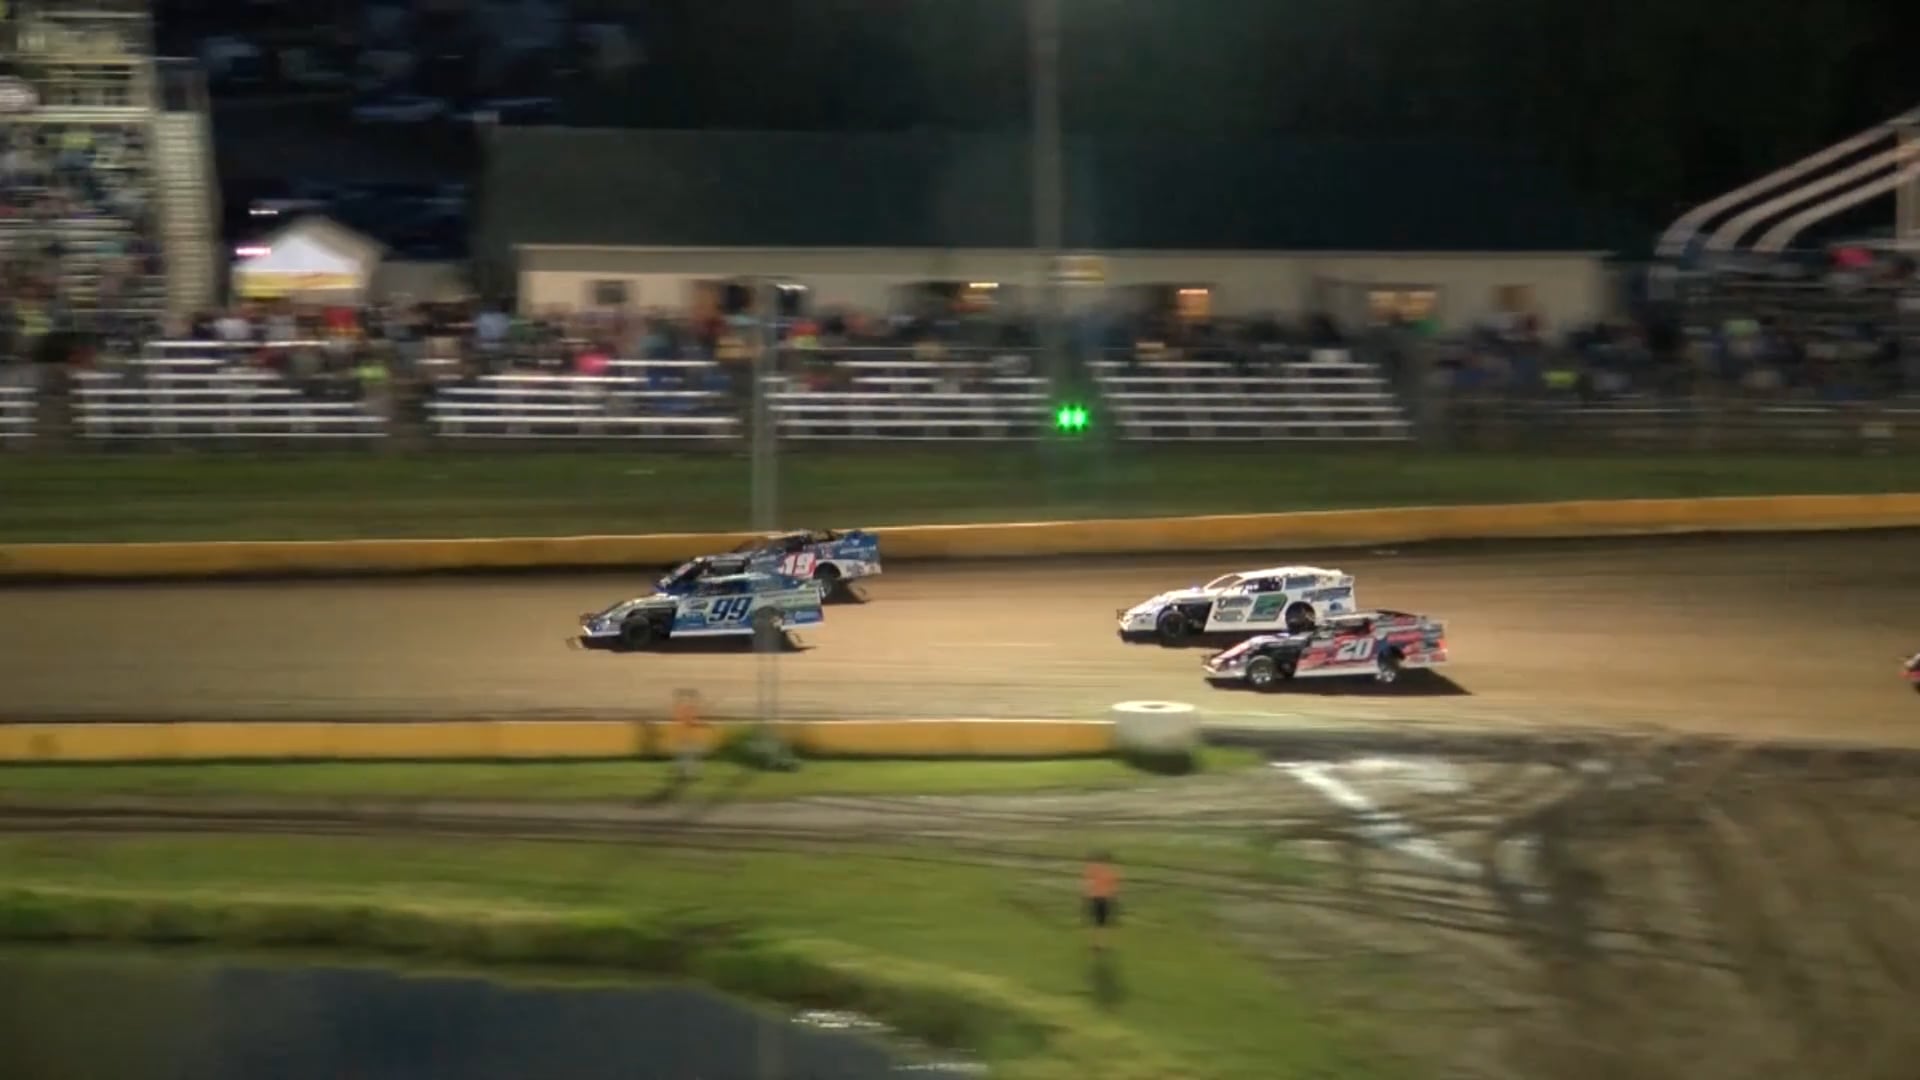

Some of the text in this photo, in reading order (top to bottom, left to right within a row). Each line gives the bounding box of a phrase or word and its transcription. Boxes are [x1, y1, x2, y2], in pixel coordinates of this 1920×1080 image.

[778, 553, 815, 576] 19
[706, 596, 753, 621] 99
[1336, 638, 1375, 660] 20
